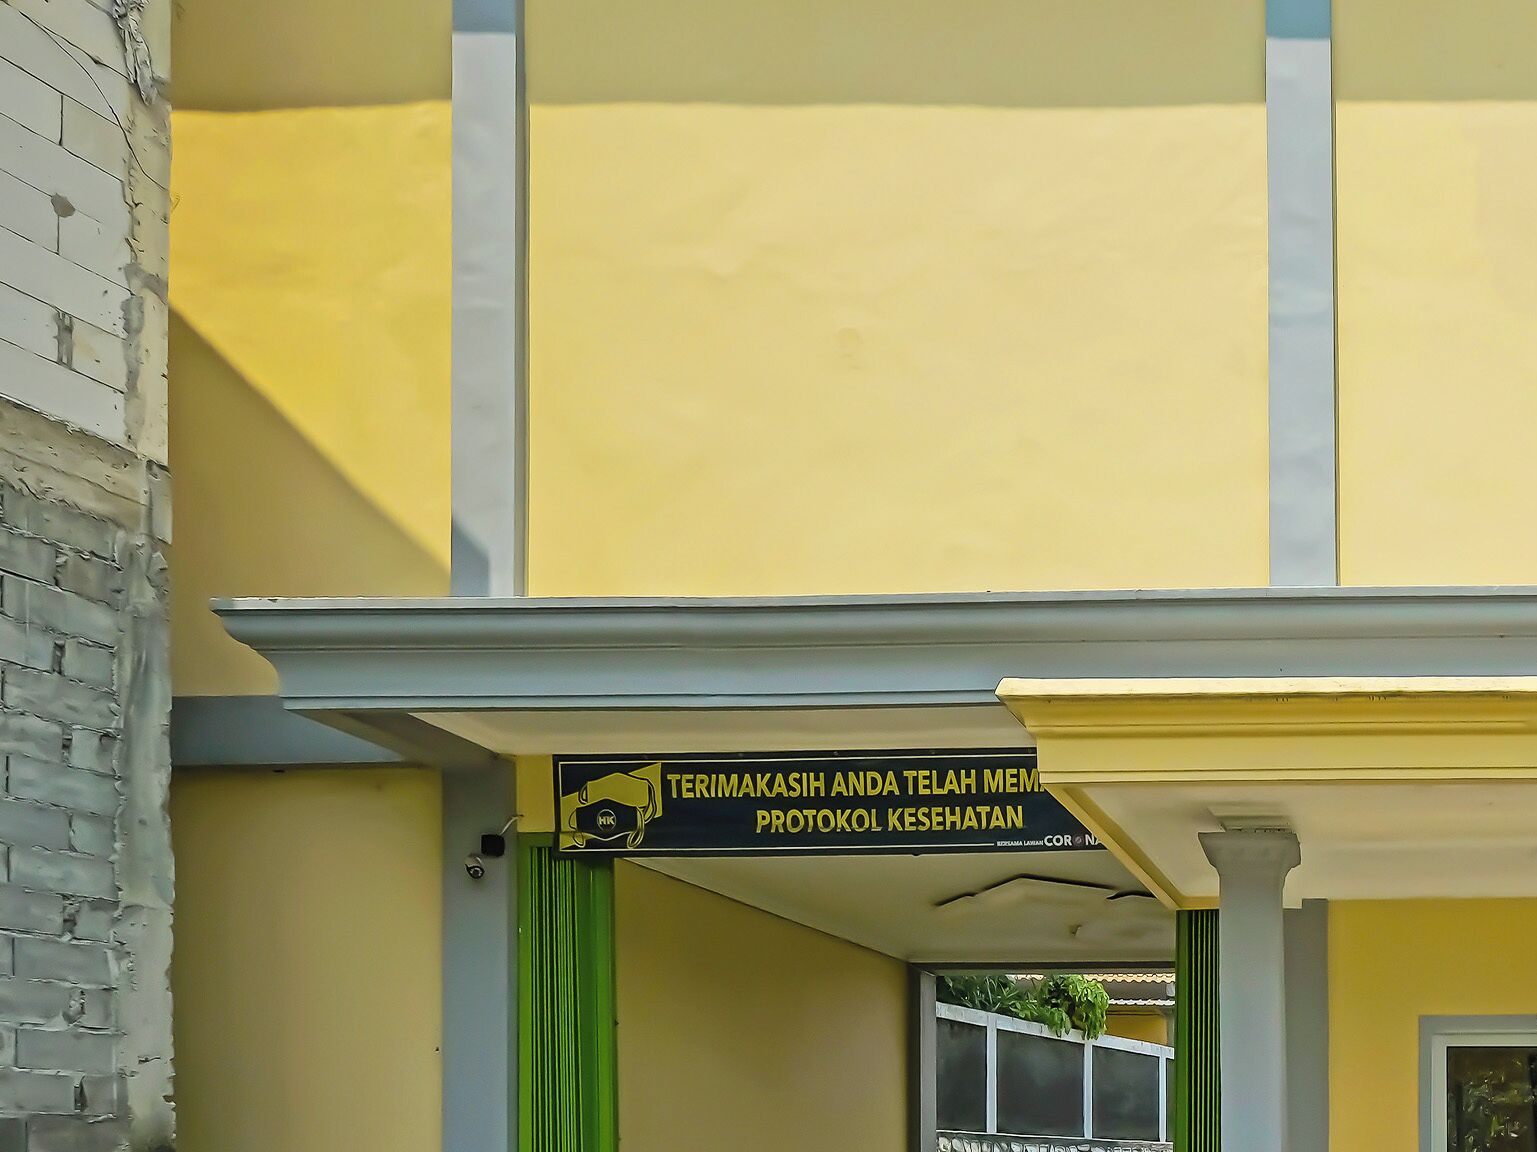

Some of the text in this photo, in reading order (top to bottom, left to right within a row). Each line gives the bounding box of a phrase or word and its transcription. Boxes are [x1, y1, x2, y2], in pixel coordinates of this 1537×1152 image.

[667, 768, 1044, 799] TERIMAKASIH ANDA TELAH MEM
[598, 816, 615, 825] HK
[756, 805, 1024, 833] PROTOKOL KESEHATAN
